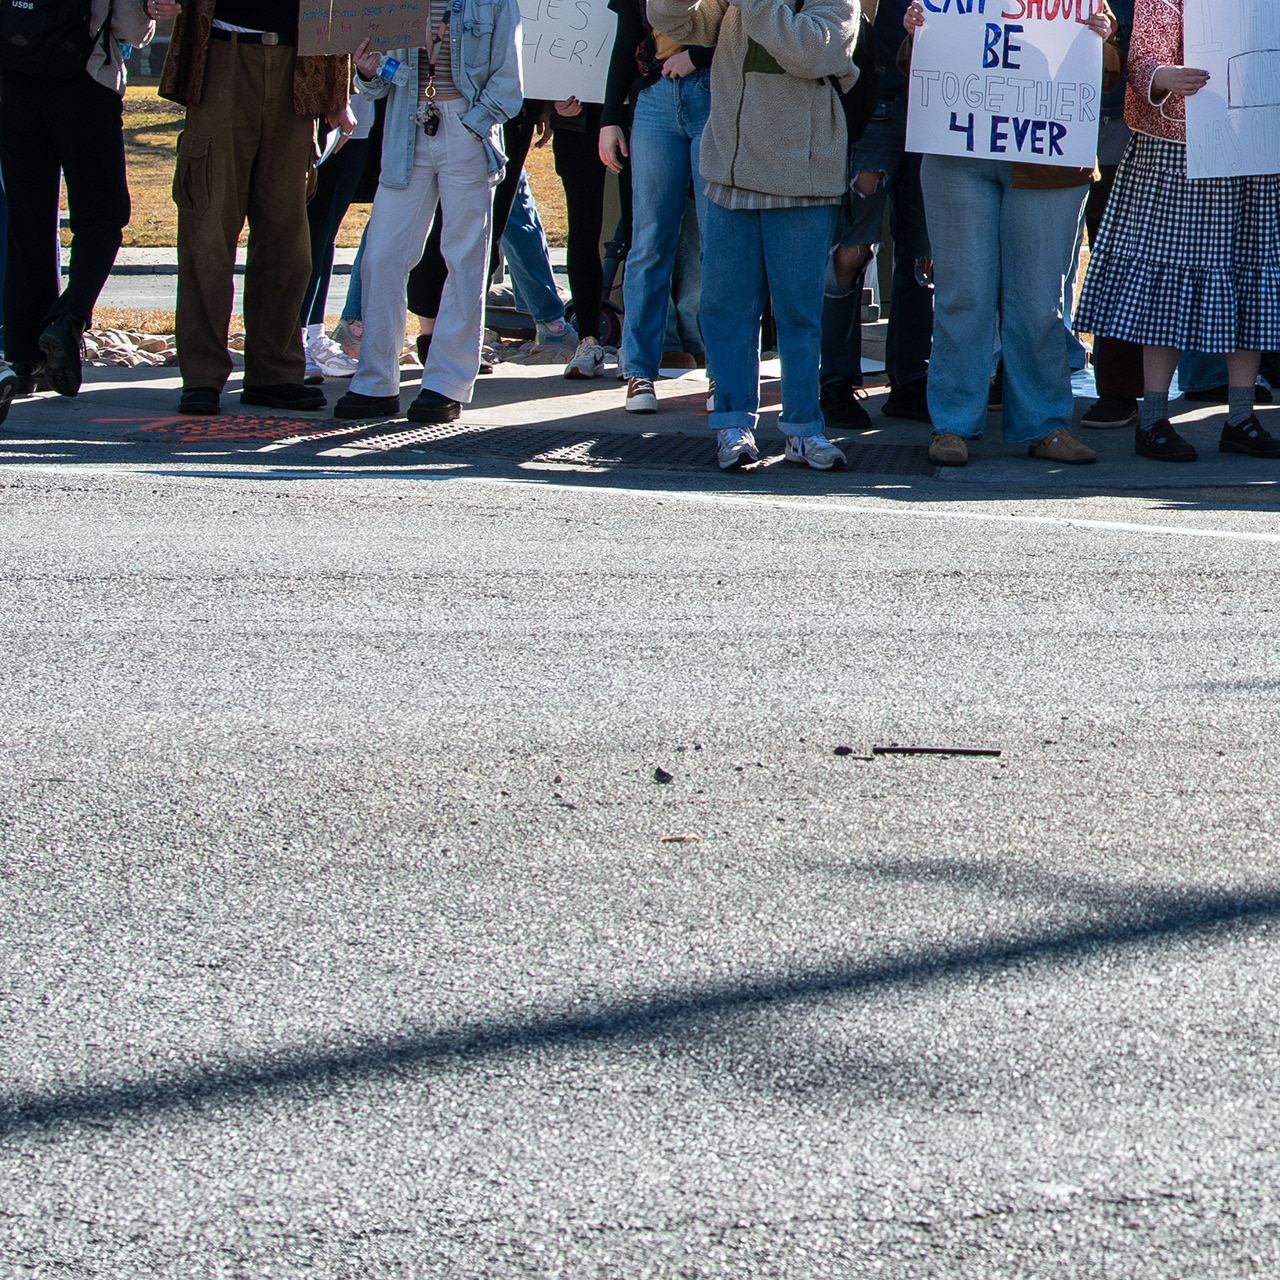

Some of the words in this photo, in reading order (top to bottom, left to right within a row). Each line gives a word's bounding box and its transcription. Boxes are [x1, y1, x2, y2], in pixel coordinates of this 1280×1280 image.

[12, 0, 34, 10] USDB
[982, 22, 1024, 70] BE
[912, 69, 1097, 122] TOGETHER
[949, 111, 975, 152] 4
[990, 115, 1067, 157] EVER
[1187, 113, 1243, 176] WAS
